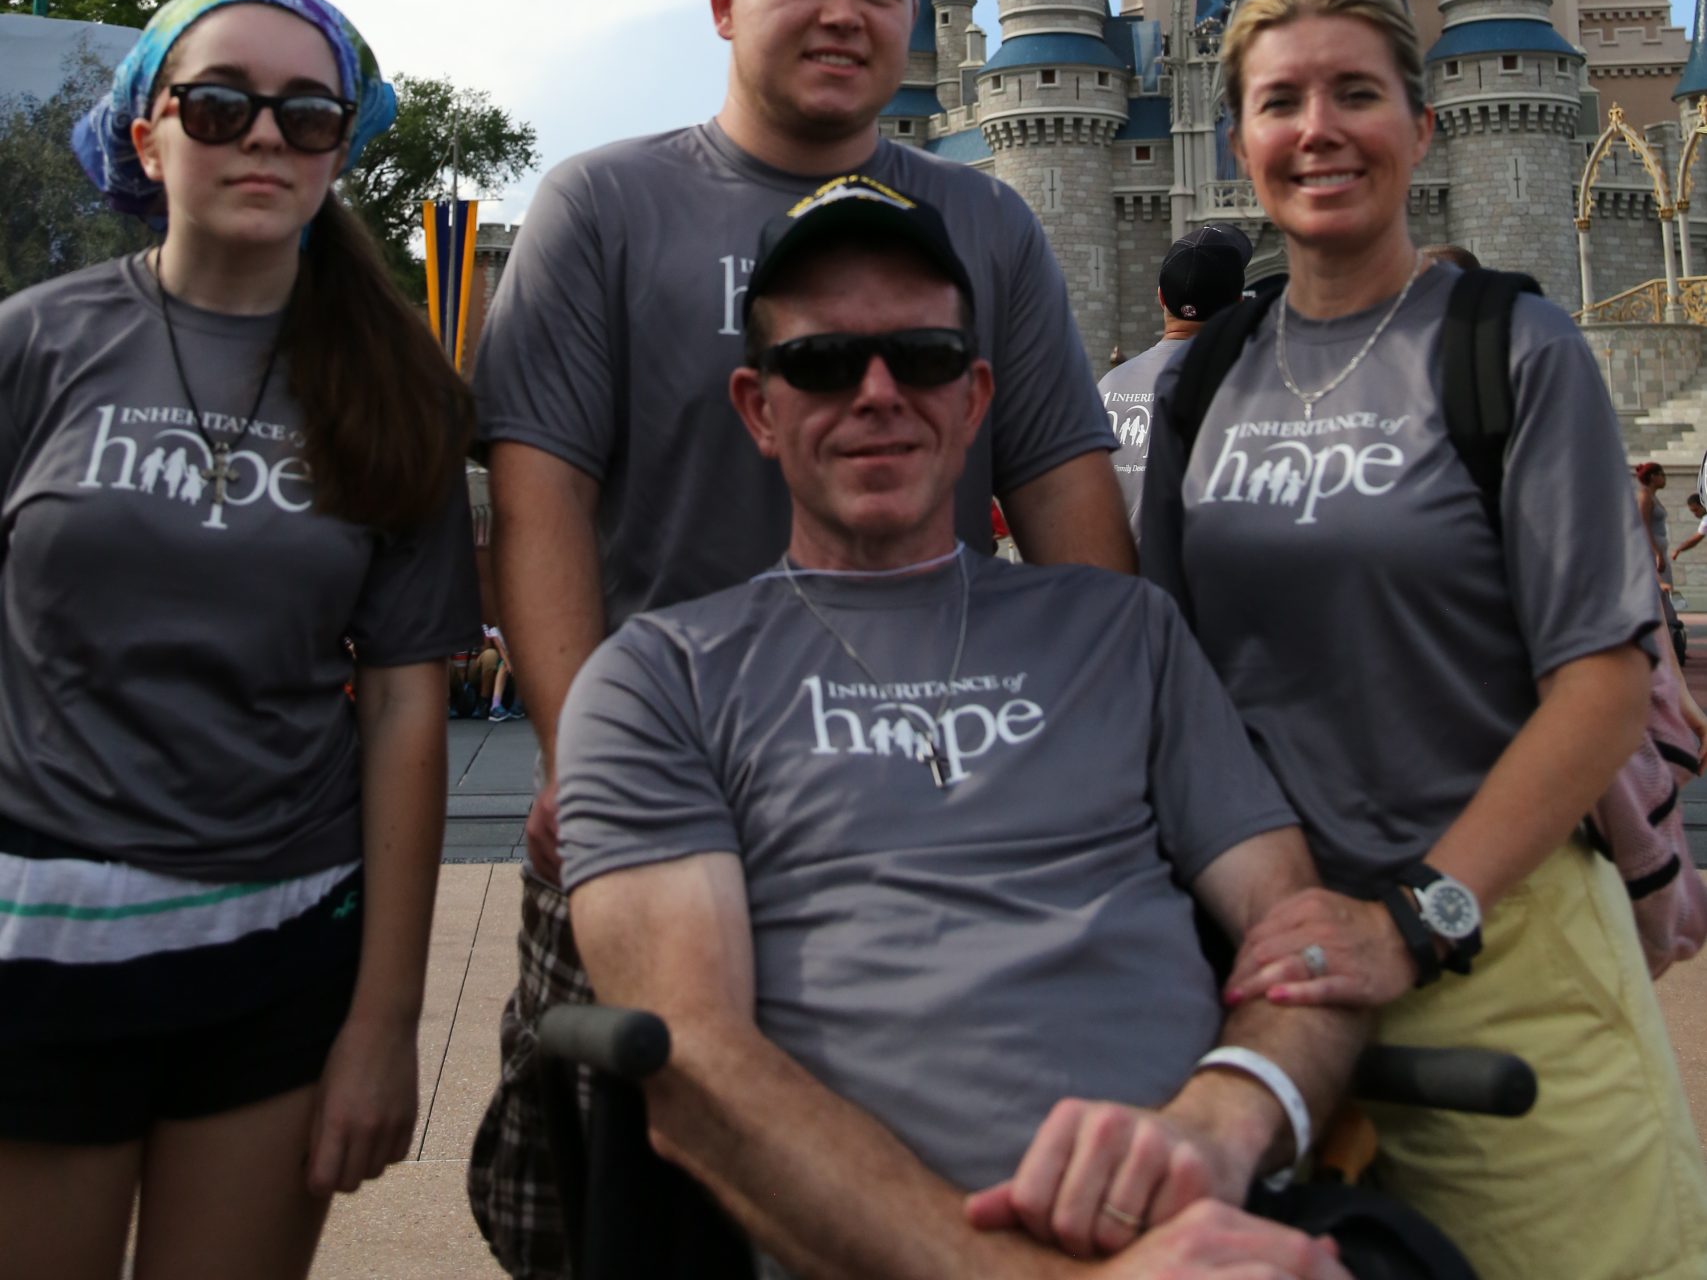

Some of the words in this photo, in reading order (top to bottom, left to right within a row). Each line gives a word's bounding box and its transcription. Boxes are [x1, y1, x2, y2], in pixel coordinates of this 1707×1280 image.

[77, 404, 313, 529] hope
[1198, 424, 1404, 524] hope
[1238, 411, 1378, 438] INHERITANCE
[1380, 414, 1410, 436] of
[803, 675, 1047, 784] hope
[1002, 672, 1028, 694] of
